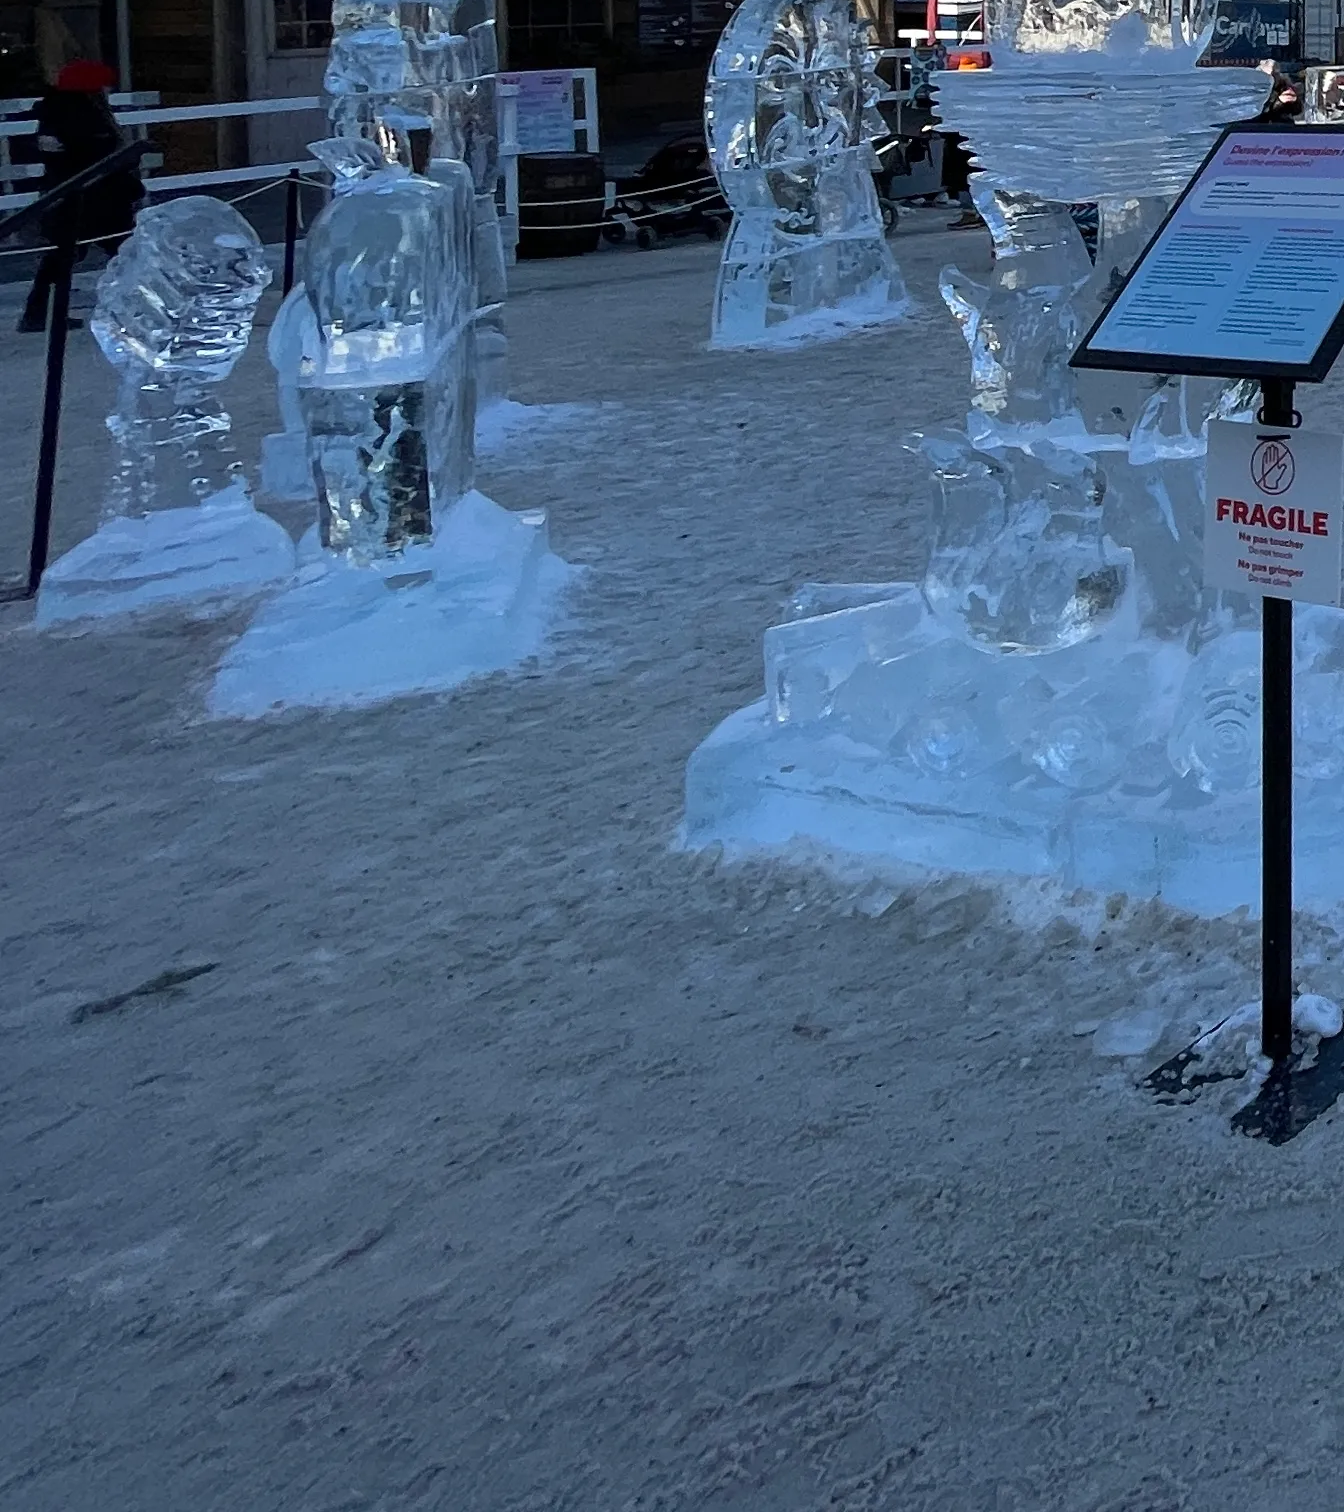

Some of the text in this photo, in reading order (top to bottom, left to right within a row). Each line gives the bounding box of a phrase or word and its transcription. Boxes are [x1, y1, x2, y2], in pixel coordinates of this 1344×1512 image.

[1216, 498, 1329, 536] FRAGILE
[1238, 531, 1304, 550] Ne pas toucher
[1238, 559, 1250, 569] Ne
[1251, 563, 1267, 572] pas
